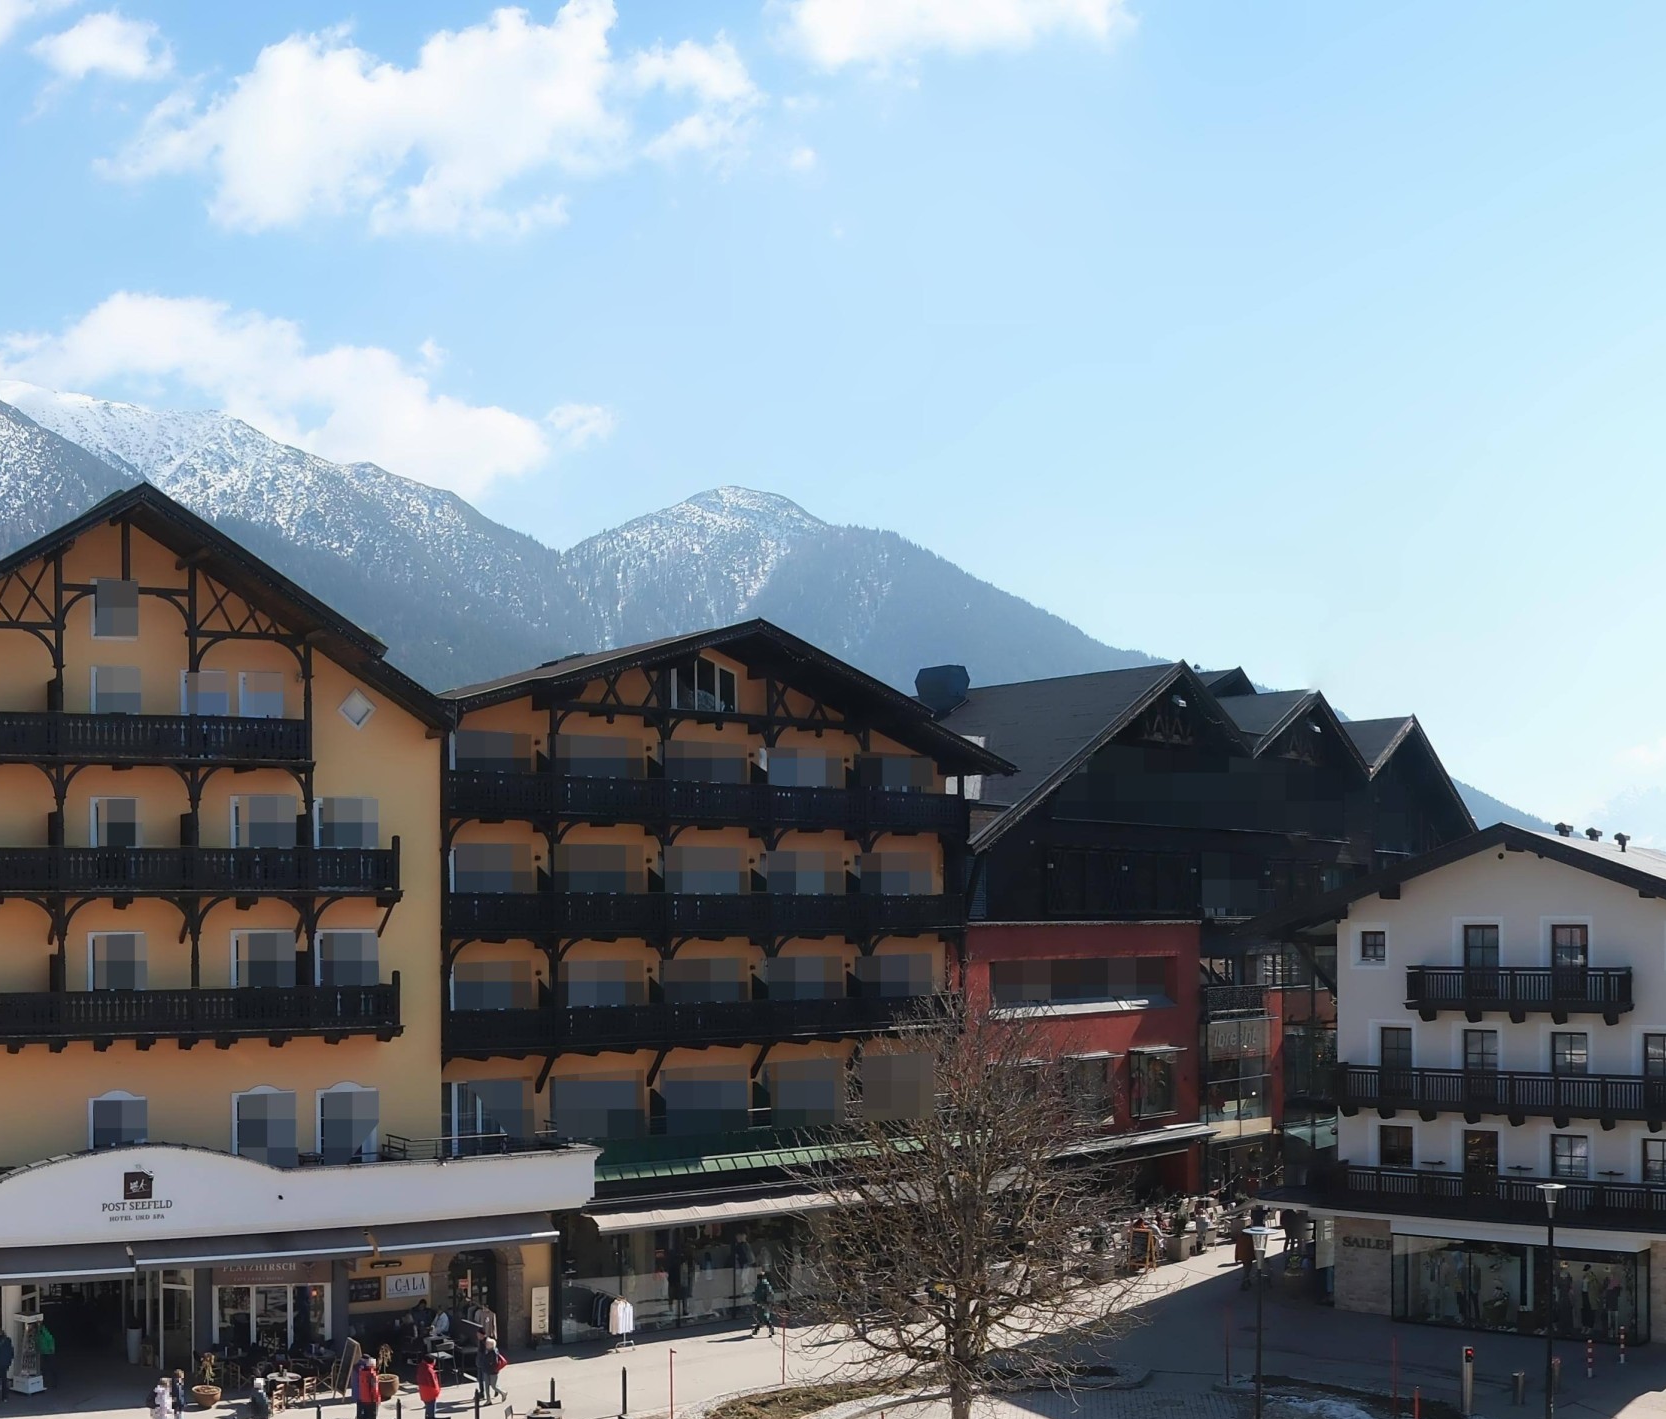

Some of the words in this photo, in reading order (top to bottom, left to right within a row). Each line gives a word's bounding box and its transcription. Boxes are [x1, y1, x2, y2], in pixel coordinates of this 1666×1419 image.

[101, 1202, 127, 1212] POST
[129, 1200, 173, 1211] SEEFELD
[222, 1262, 296, 1272] PLATZHIRSCH
